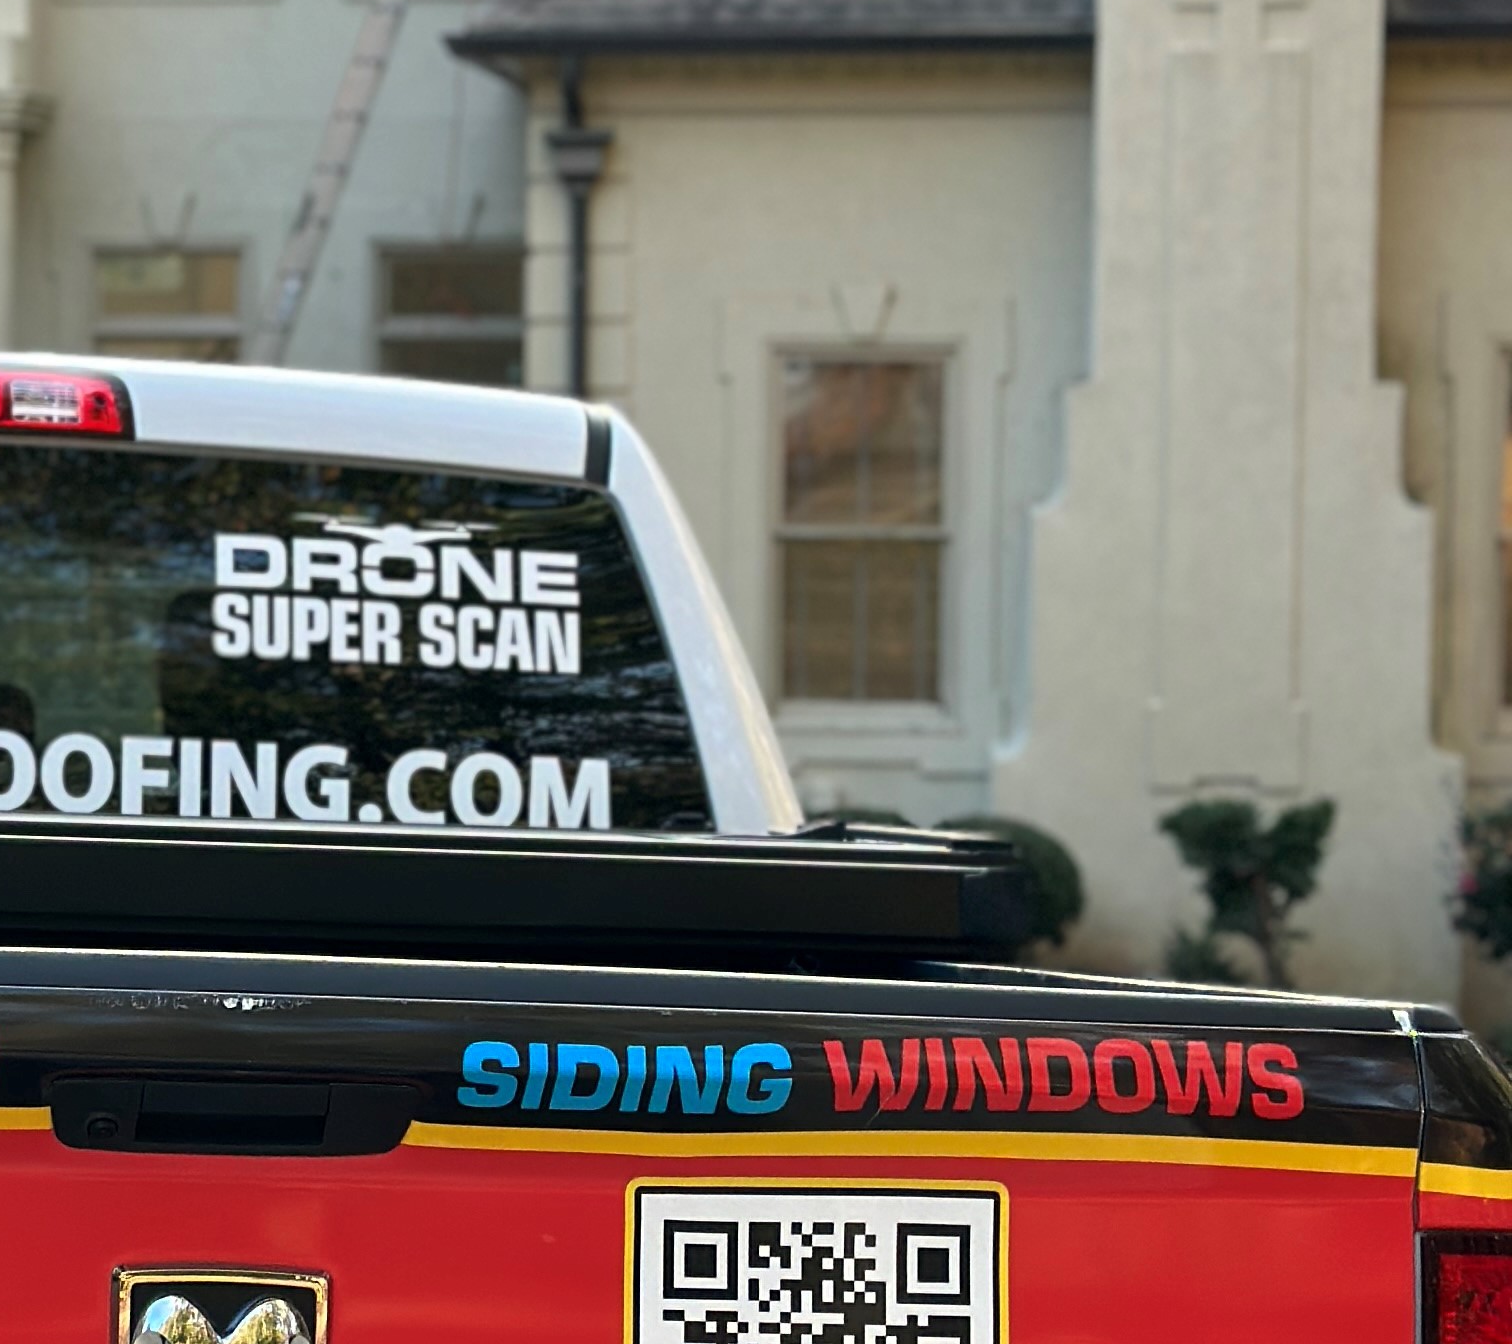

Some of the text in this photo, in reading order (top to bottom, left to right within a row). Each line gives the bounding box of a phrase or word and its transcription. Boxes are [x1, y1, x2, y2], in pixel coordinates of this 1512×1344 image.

[213, 532, 581, 606] DRONE
[211, 592, 582, 675] SUPER SCAN
[455, 1036, 1307, 1122] SIDING WINDOWS
